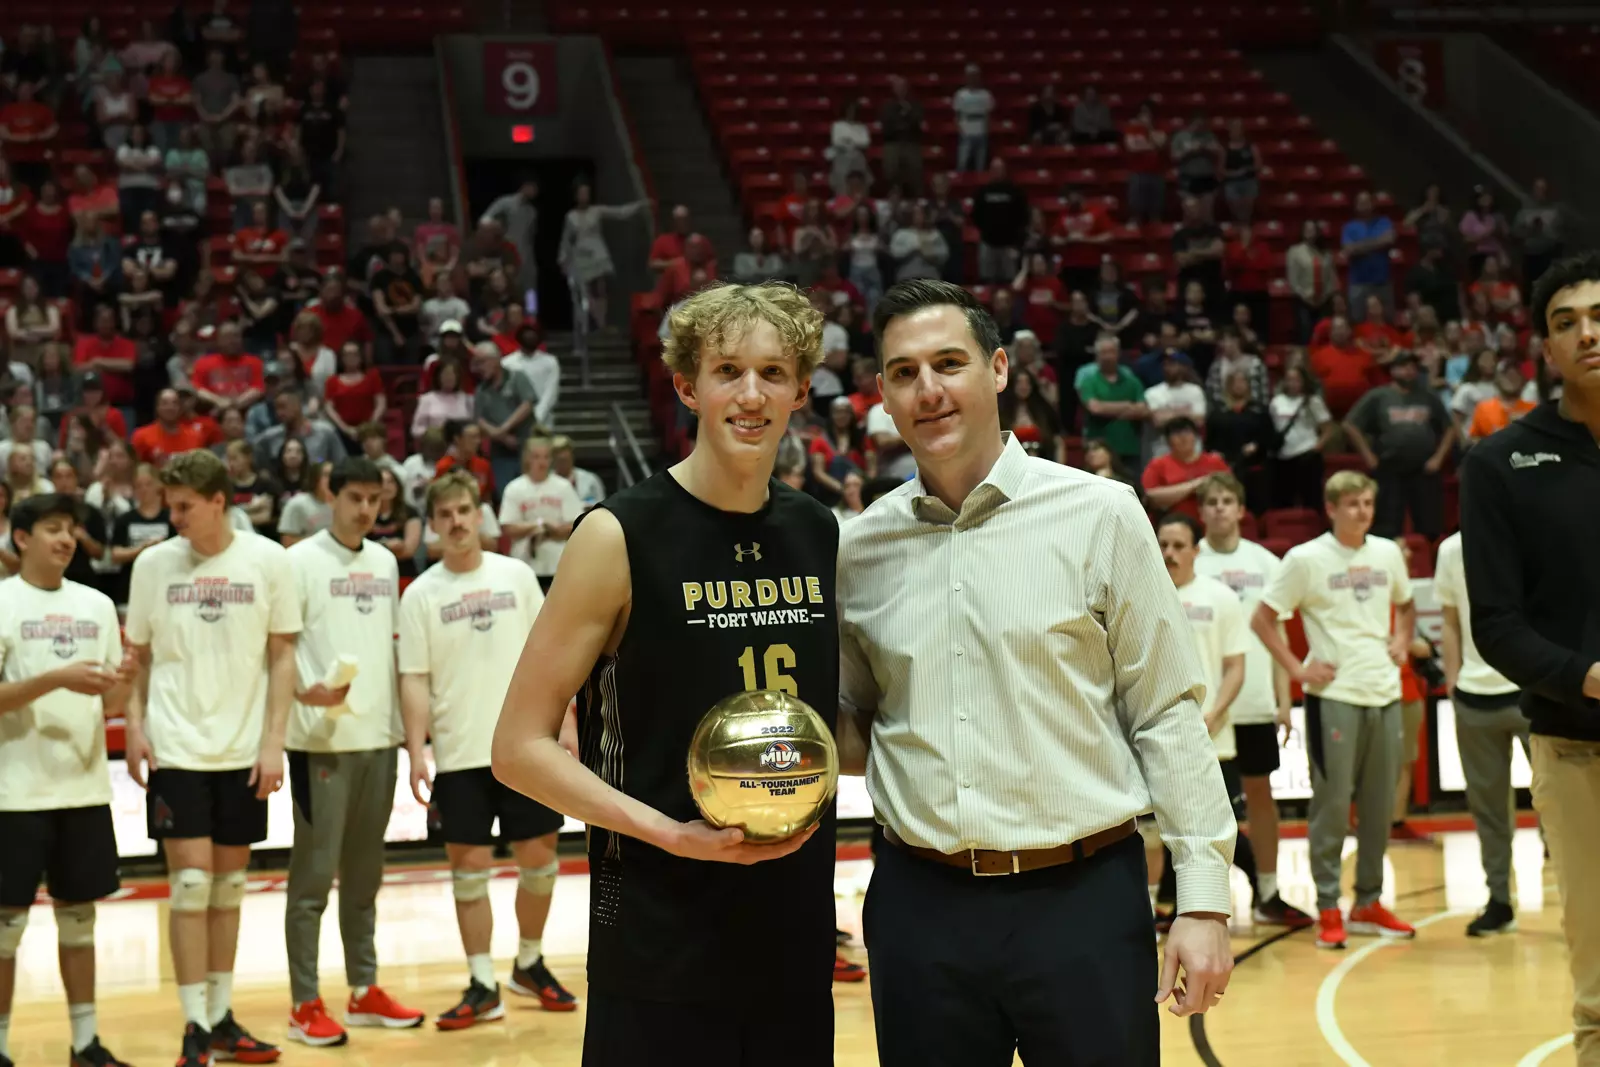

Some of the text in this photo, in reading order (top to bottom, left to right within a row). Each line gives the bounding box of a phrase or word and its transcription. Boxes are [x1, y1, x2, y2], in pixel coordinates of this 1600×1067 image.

[502, 61, 540, 110] 9
[682, 576, 824, 610] PURDUE
[707, 609, 809, 628] FORT WAYNE
[738, 643, 798, 698] 16
[761, 725, 795, 735] 2022
[760, 750, 801, 765] MIVA
[740, 775, 820, 789] ALL-TOURNAMENT
[769, 787, 796, 796] TEAM
